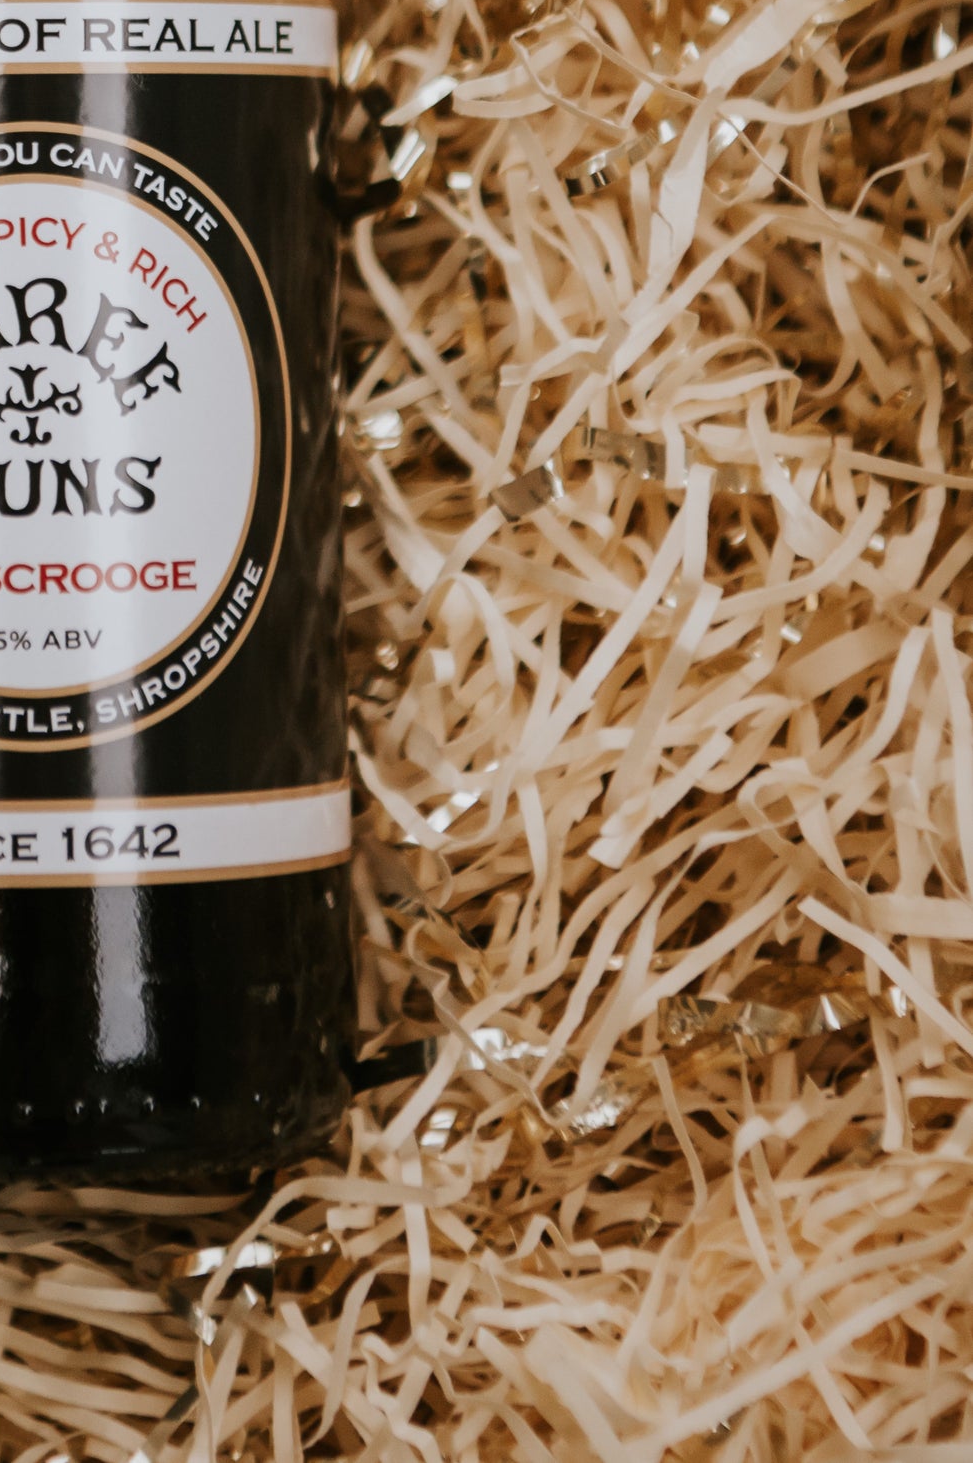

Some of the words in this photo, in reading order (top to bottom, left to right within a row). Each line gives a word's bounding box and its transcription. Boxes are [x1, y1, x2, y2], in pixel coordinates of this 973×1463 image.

[82, 18, 215, 53] REAL
[225, 19, 293, 54] ALE
[49, 142, 125, 180] CAN
[132, 162, 218, 241] TASTE
[94, 230, 121, 265] &
[129, 246, 209, 334] RICH
[42, 629, 104, 652] ABV
[95, 558, 264, 724] SHROPSHIRE
[61, 824, 181, 863] 1642
